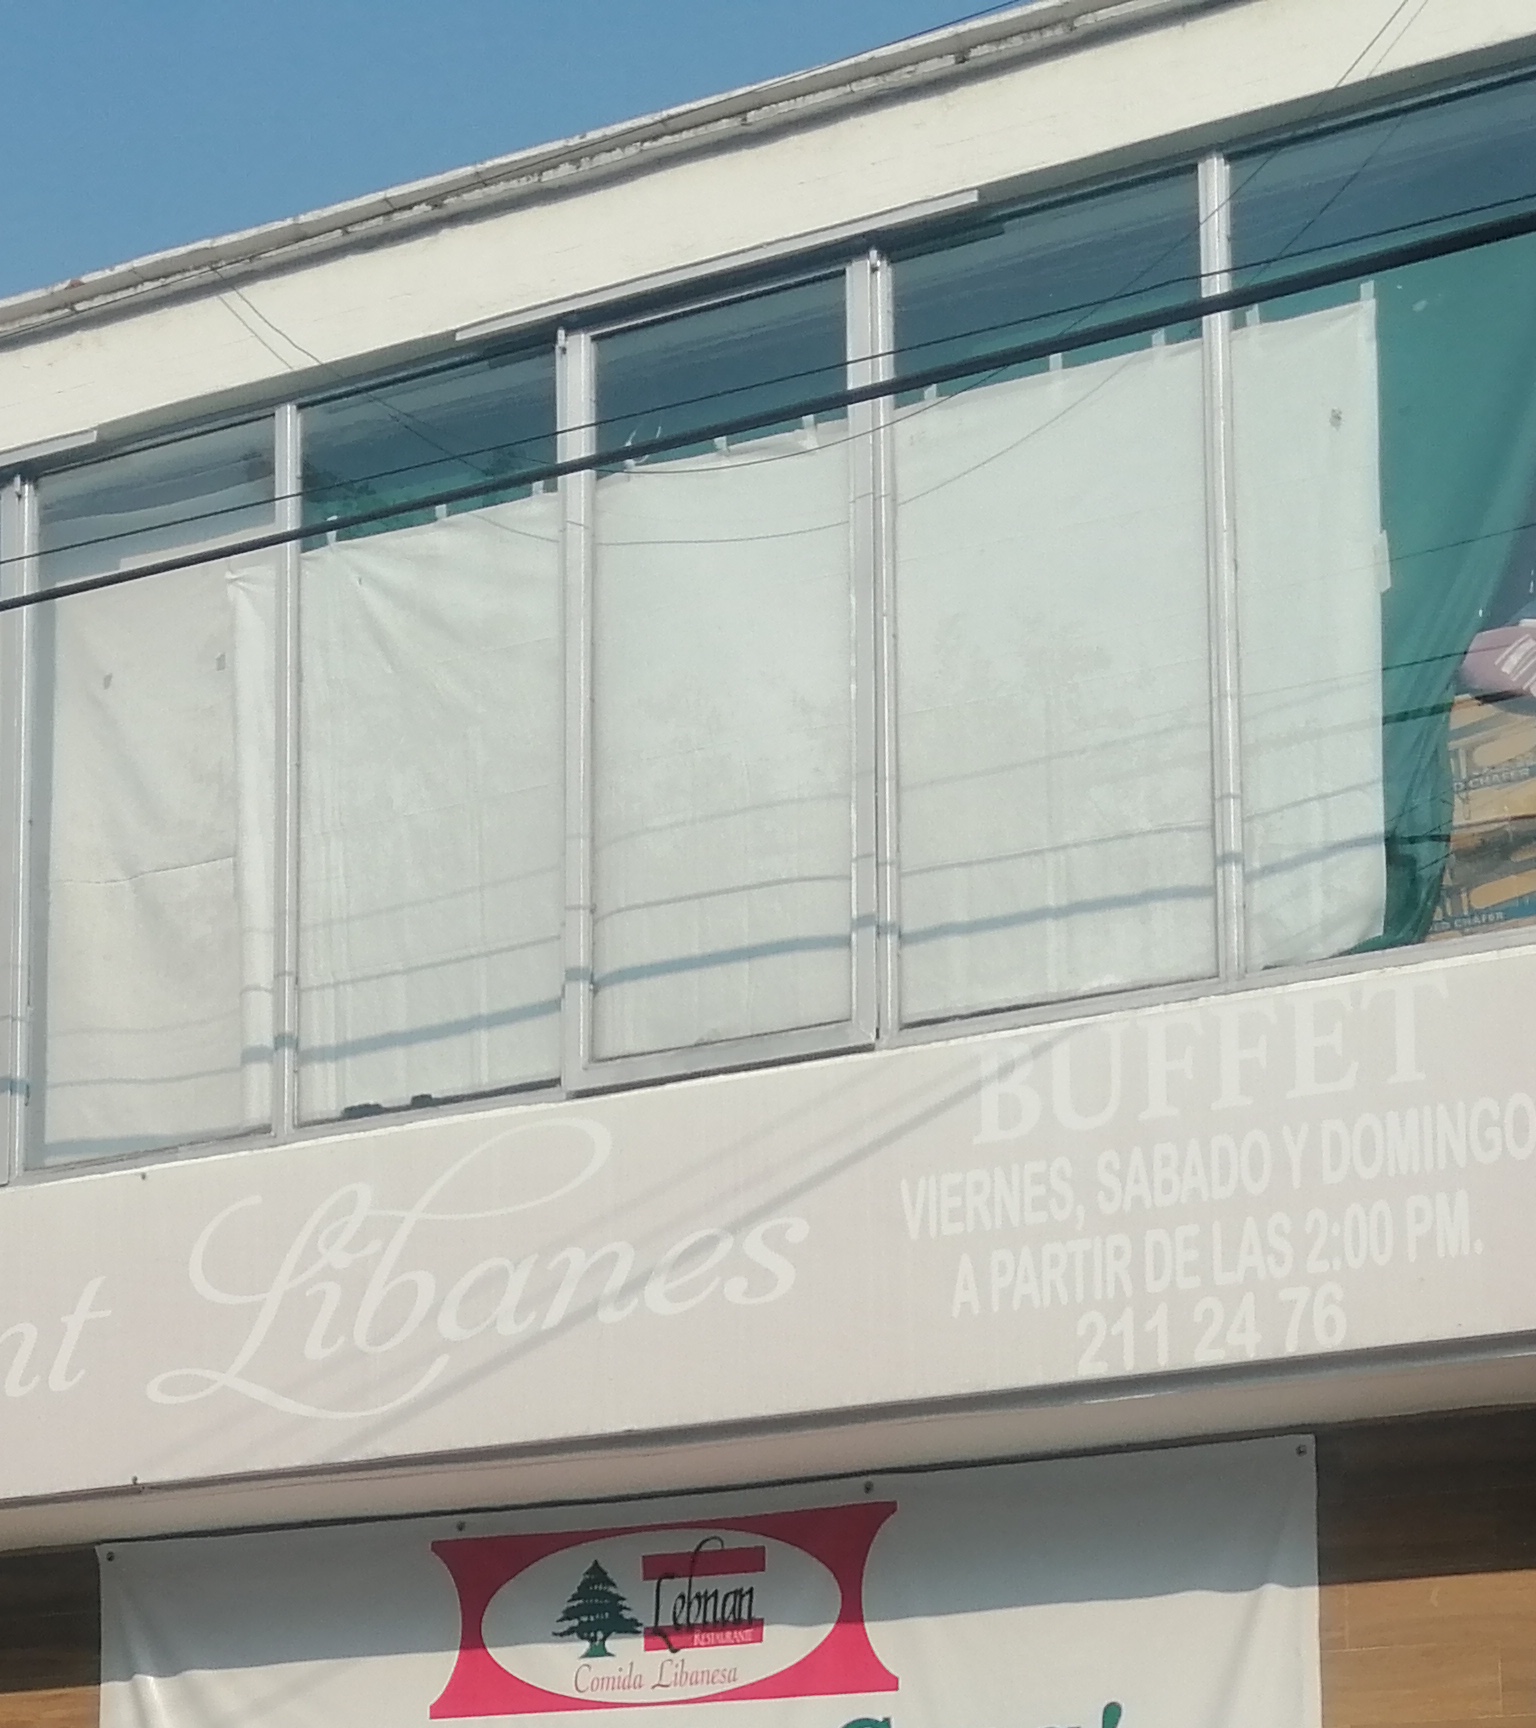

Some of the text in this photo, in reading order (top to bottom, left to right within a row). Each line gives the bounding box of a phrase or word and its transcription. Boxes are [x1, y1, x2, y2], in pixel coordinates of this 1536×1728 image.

[971, 975, 1449, 1147] BUFFET
[900, 1155, 1086, 1242] VIERNES,
[1096, 1131, 1272, 1215] SABADO
[1281, 1124, 1310, 1188] Y
[145, 1118, 809, 1422] Libanes
[951, 1189, 1484, 1318] A PARTIR DE LAS 2:00 PM.
[1076, 1283, 1348, 1375] 211 24 76
[650, 1536, 754, 1653] Lebnan
[574, 1659, 738, 1694] Comida Libanesa
